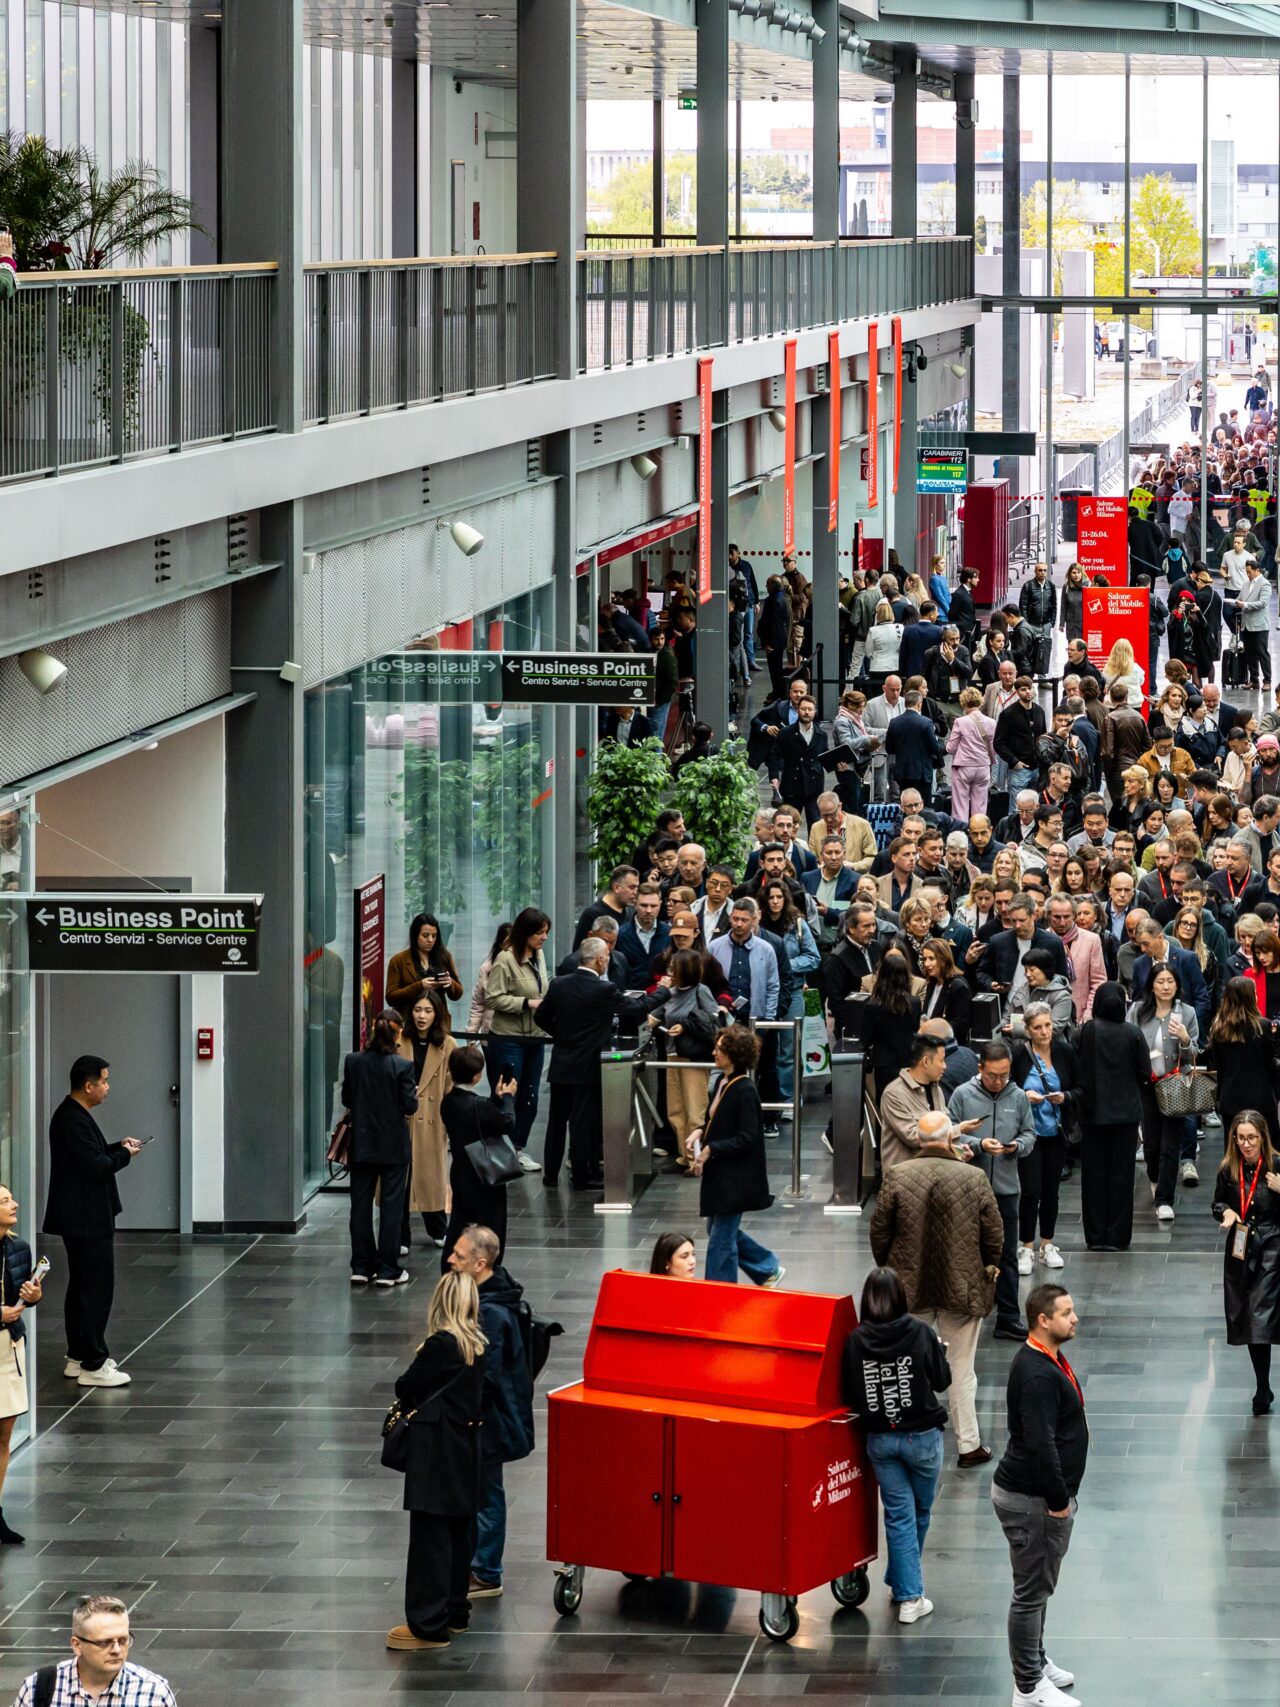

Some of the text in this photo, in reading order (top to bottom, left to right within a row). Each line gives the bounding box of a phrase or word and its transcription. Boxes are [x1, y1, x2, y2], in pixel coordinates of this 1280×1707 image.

[1107, 592, 1131, 600] Salone
[1107, 600, 1145, 608] del Mobile.
[1107, 607, 1132, 615] Milano
[522, 660, 647, 676] Business Point
[521, 676, 550, 686] Centro
[551, 677, 580, 686] Servizi
[586, 678, 618, 687] Service
[619, 678, 648, 687] Centre
[58, 907, 245, 928] Business Point
[59, 932, 101, 945] Centro
[105, 933, 146, 945] Servizi
[156, 934, 202, 945] Service
[205, 934, 247, 946] Centre
[862, 1359, 881, 1412] Milano
[896, 1355, 914, 1408] Salone
[827, 1459, 851, 1477] Salone
[827, 1475, 839, 1491] del
[827, 1486, 851, 1506] Milano
